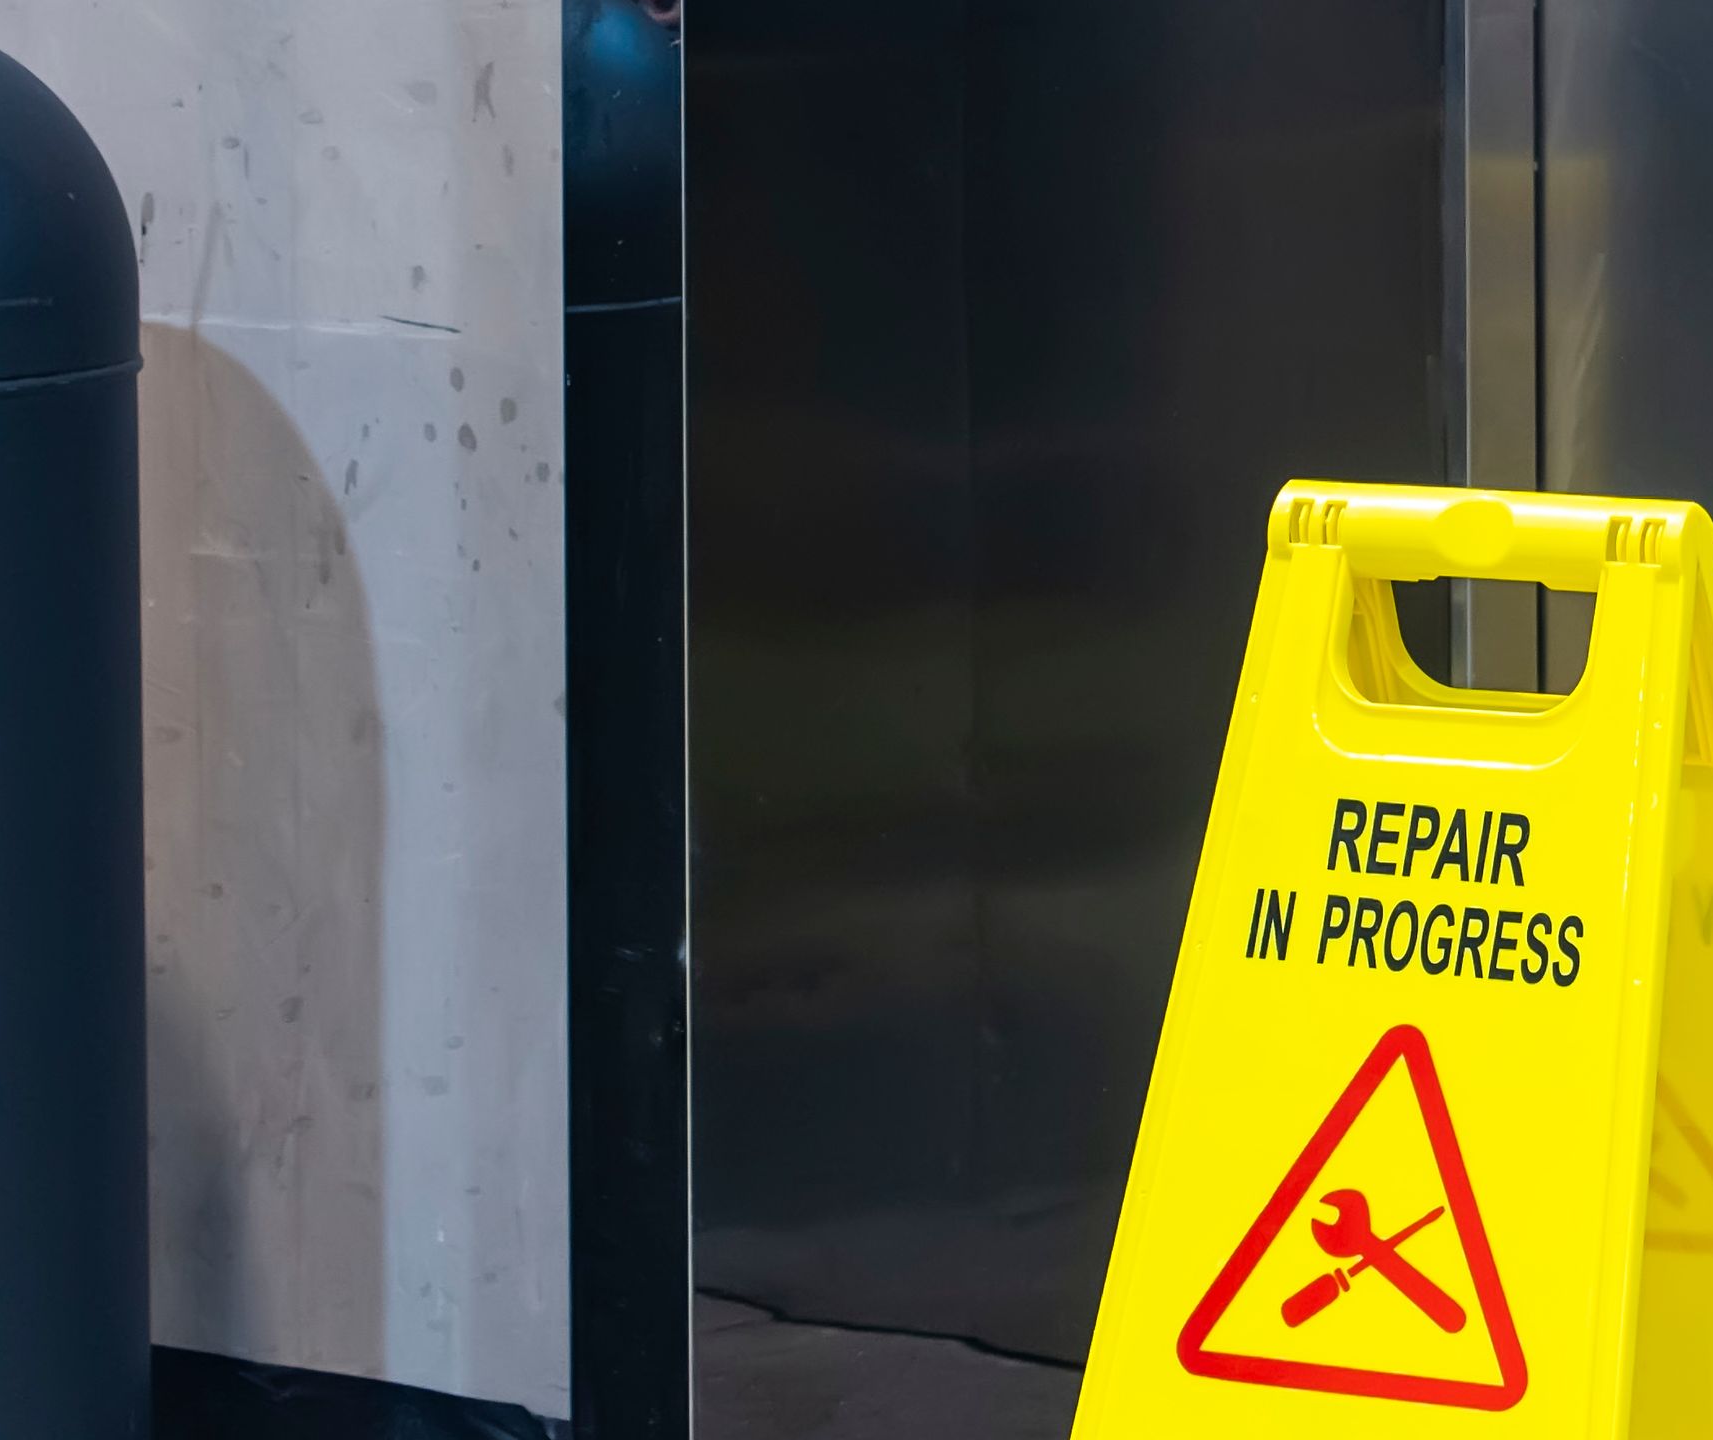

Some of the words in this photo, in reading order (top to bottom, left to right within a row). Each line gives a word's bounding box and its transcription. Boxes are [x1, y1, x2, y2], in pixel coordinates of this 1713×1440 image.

[1327, 798, 1531, 887] REPAIR
[1245, 888, 1297, 961] IN
[1316, 894, 1584, 987] PROGRESS
